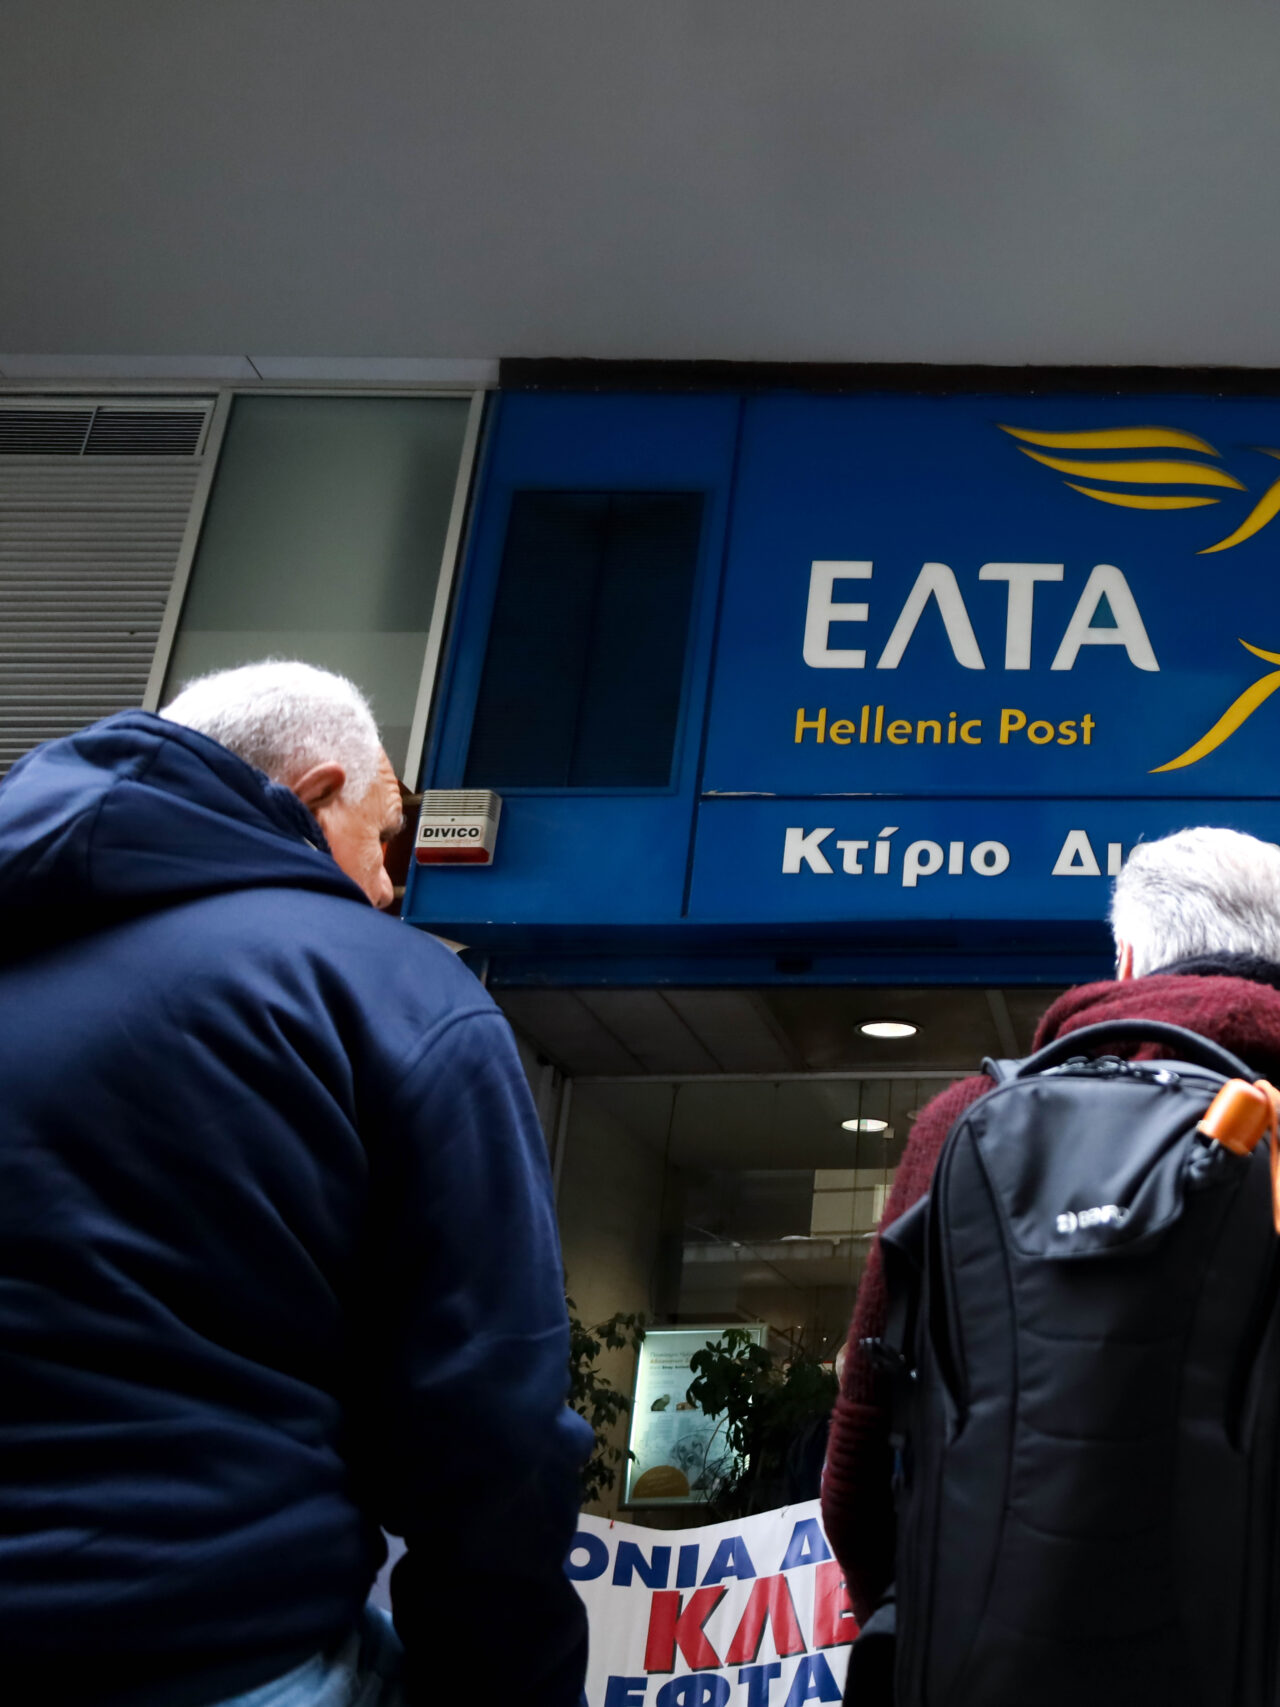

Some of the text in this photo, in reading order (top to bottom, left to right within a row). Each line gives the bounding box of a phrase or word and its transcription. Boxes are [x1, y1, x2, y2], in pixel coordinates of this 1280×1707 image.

[803, 560, 1160, 671] ΕΛΤΑ
[794, 705, 1096, 745] Hellenic Post
[423, 827, 480, 838] DIVICO
[782, 827, 1011, 887] Κτίριο
[580, 1652, 844, 1707] ΕΦΤΑ
